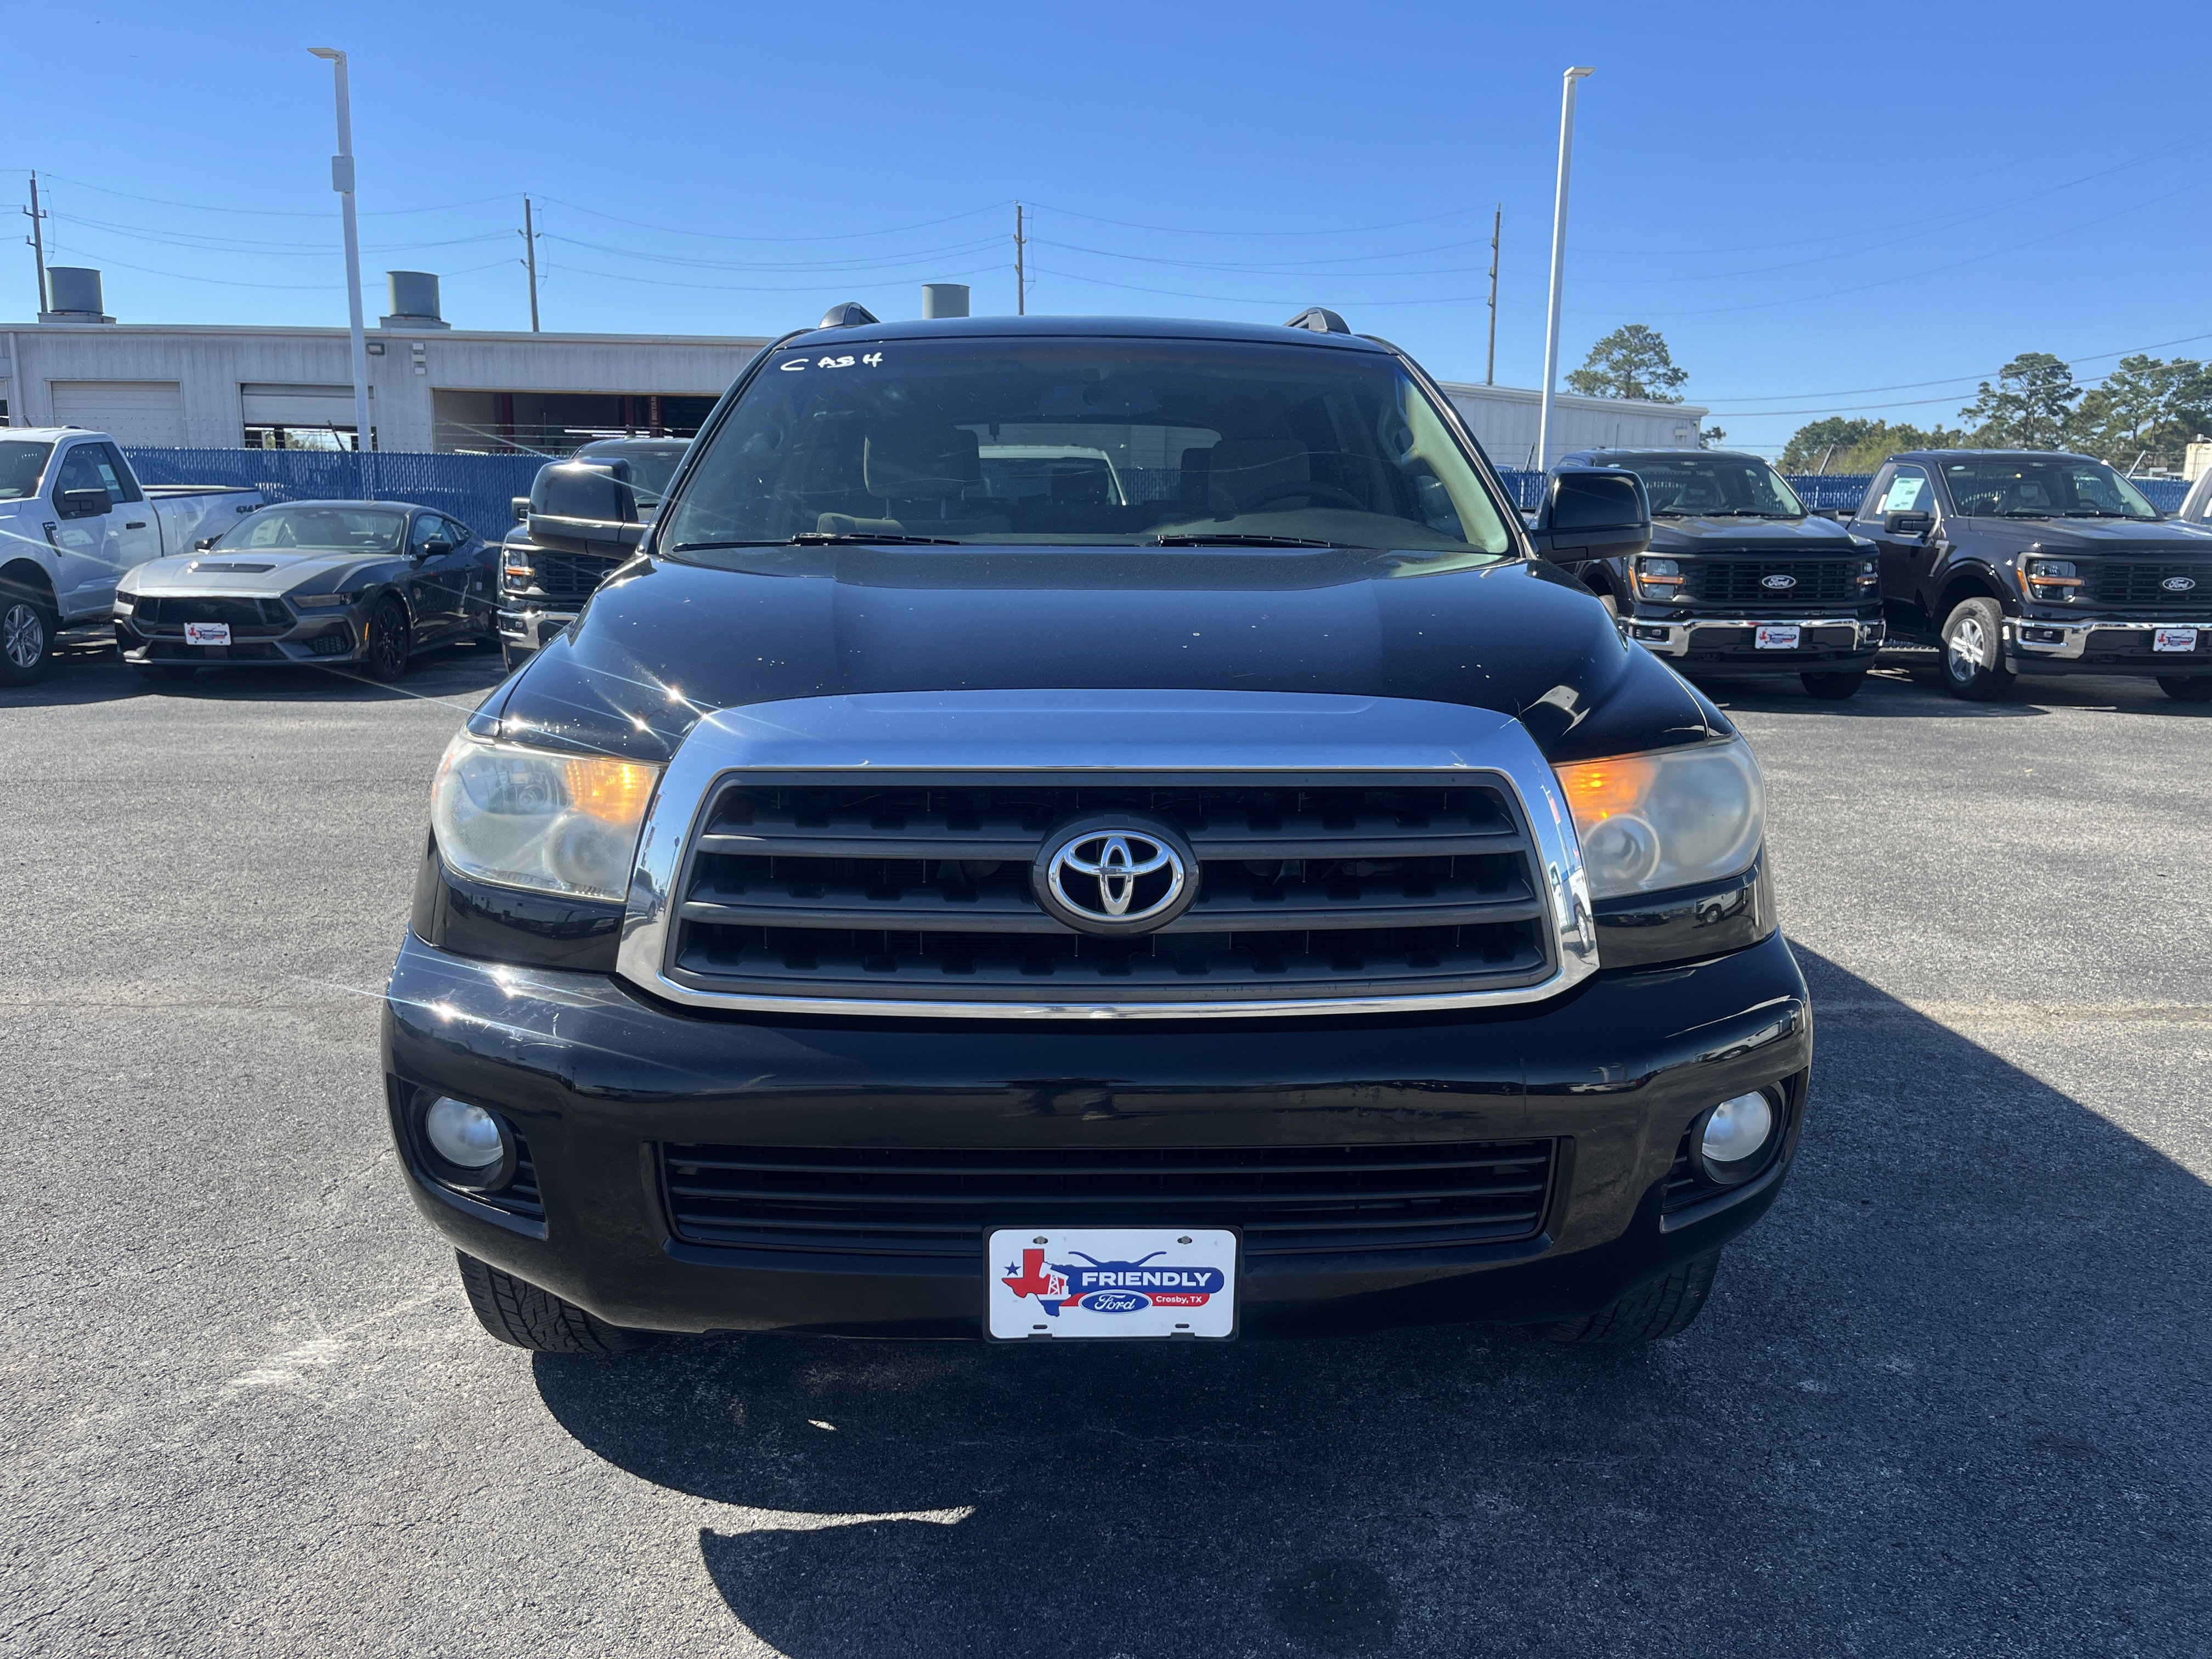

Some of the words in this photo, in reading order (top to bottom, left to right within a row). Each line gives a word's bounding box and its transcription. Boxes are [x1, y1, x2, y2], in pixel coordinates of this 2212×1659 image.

[1081, 1271, 1212, 1287] FRIENDLY
[1094, 1294, 1136, 1310] Ford
[1155, 1295, 1189, 1304] Crosby,
